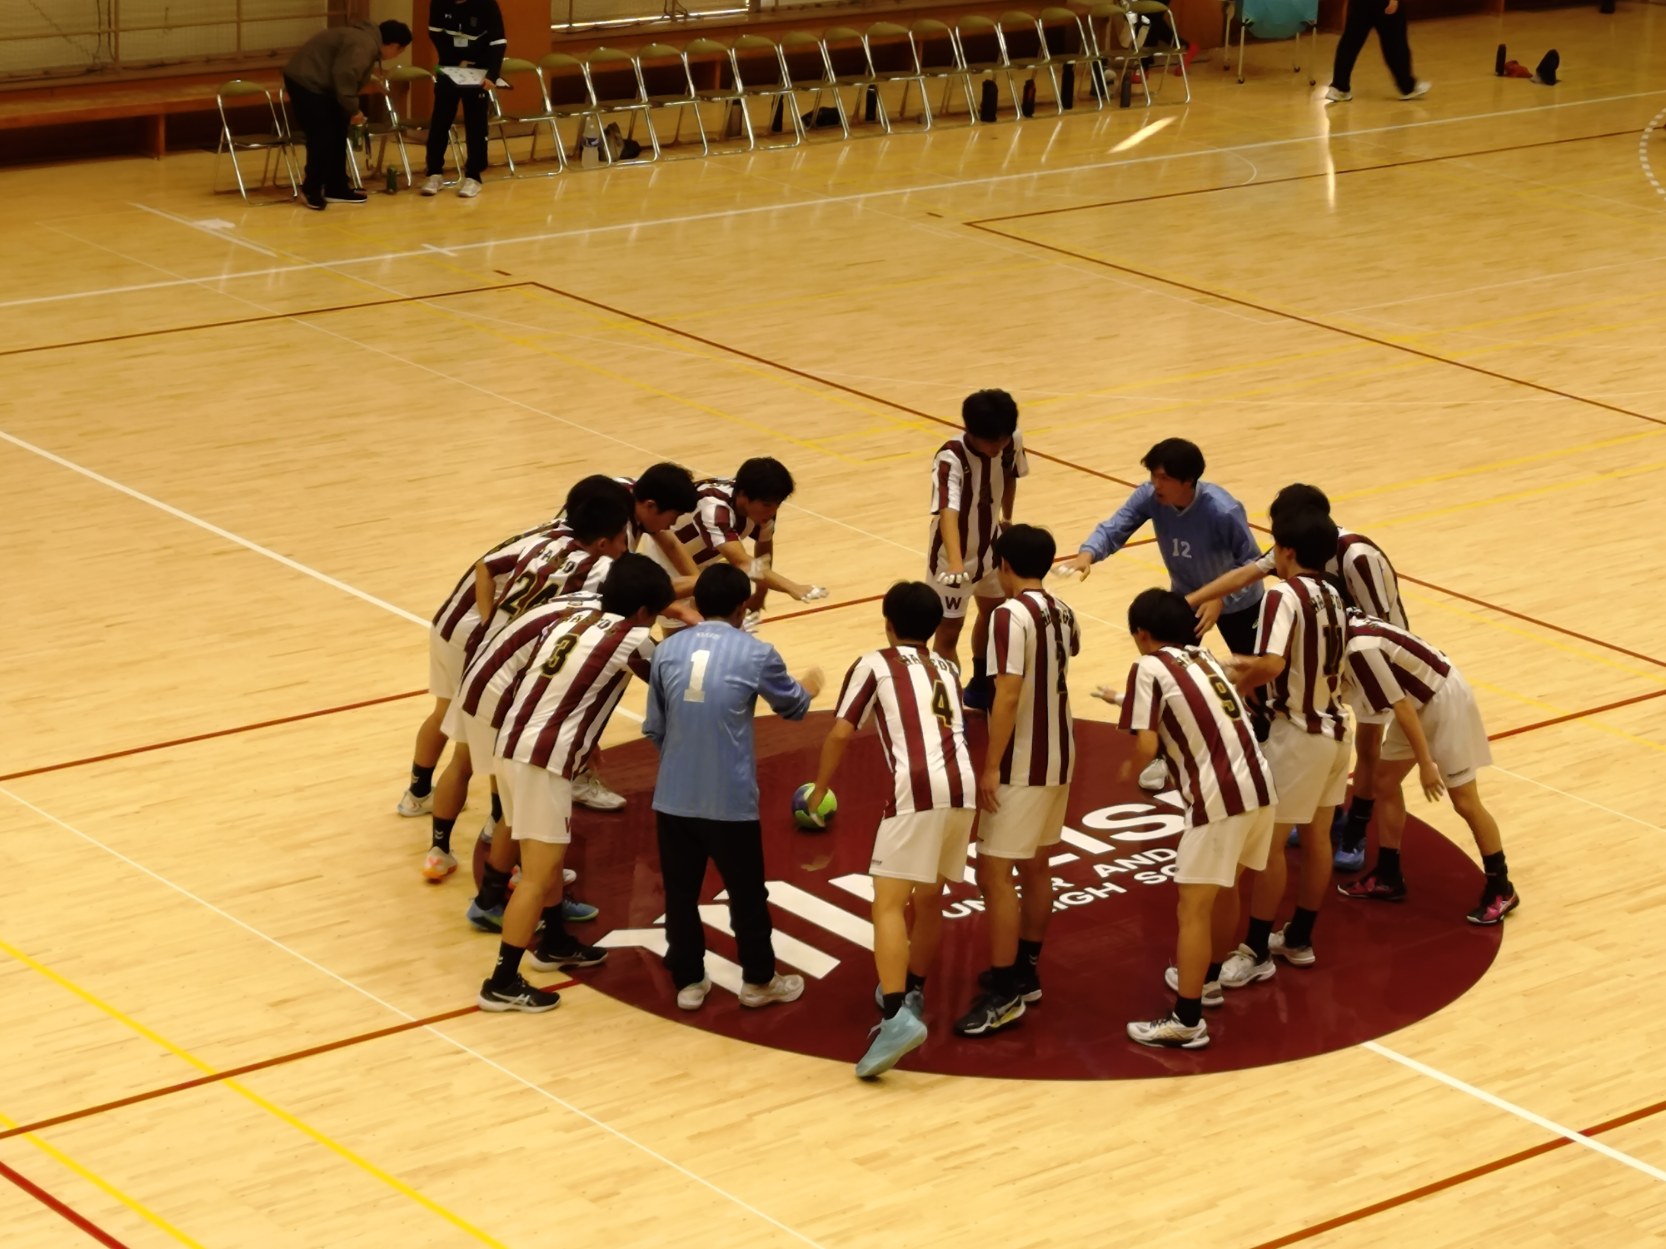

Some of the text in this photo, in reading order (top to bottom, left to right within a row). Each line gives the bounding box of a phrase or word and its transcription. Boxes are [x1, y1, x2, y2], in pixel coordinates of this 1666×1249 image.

[1171, 538, 1192, 558] 12
[945, 596, 962, 610] W
[541, 633, 579, 678] 3
[683, 649, 710, 702] 1
[932, 679, 953, 728] 4
[1207, 673, 1241, 721] 9
[1093, 848, 1177, 878] AND
[1052, 882, 1128, 913] IGH
